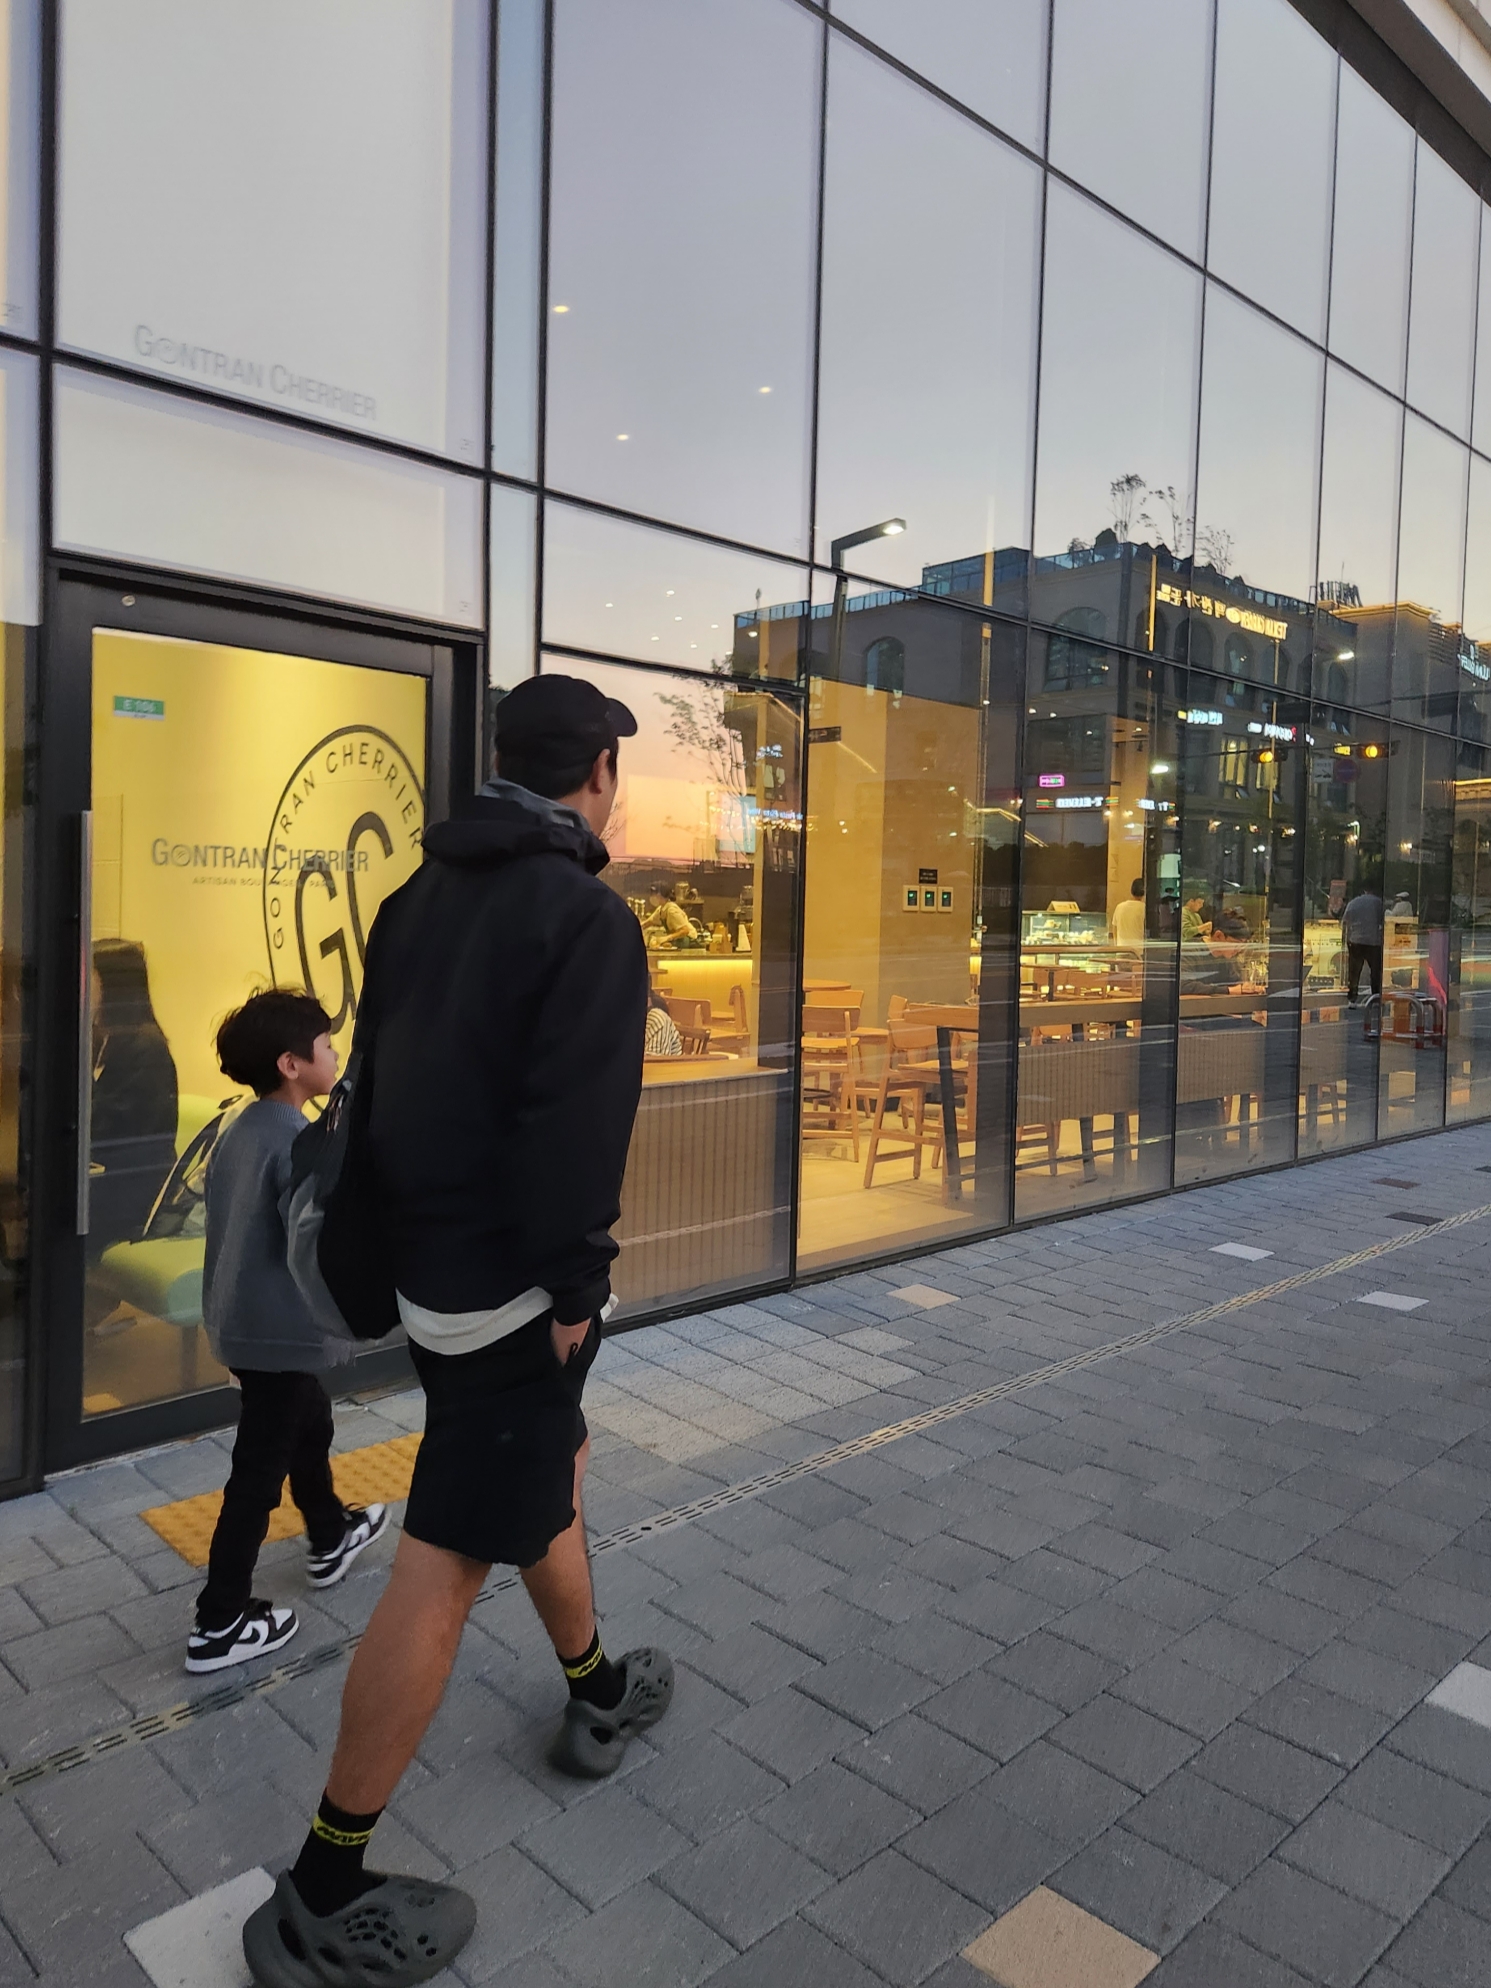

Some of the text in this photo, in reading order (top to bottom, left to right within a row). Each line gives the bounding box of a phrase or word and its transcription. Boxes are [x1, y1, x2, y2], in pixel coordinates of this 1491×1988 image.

[134, 324, 377, 421] GONTRAN CHERRIER
[325, 742, 424, 851] CHERRIER
[152, 838, 369, 872] GONTRAN CHERRIER
